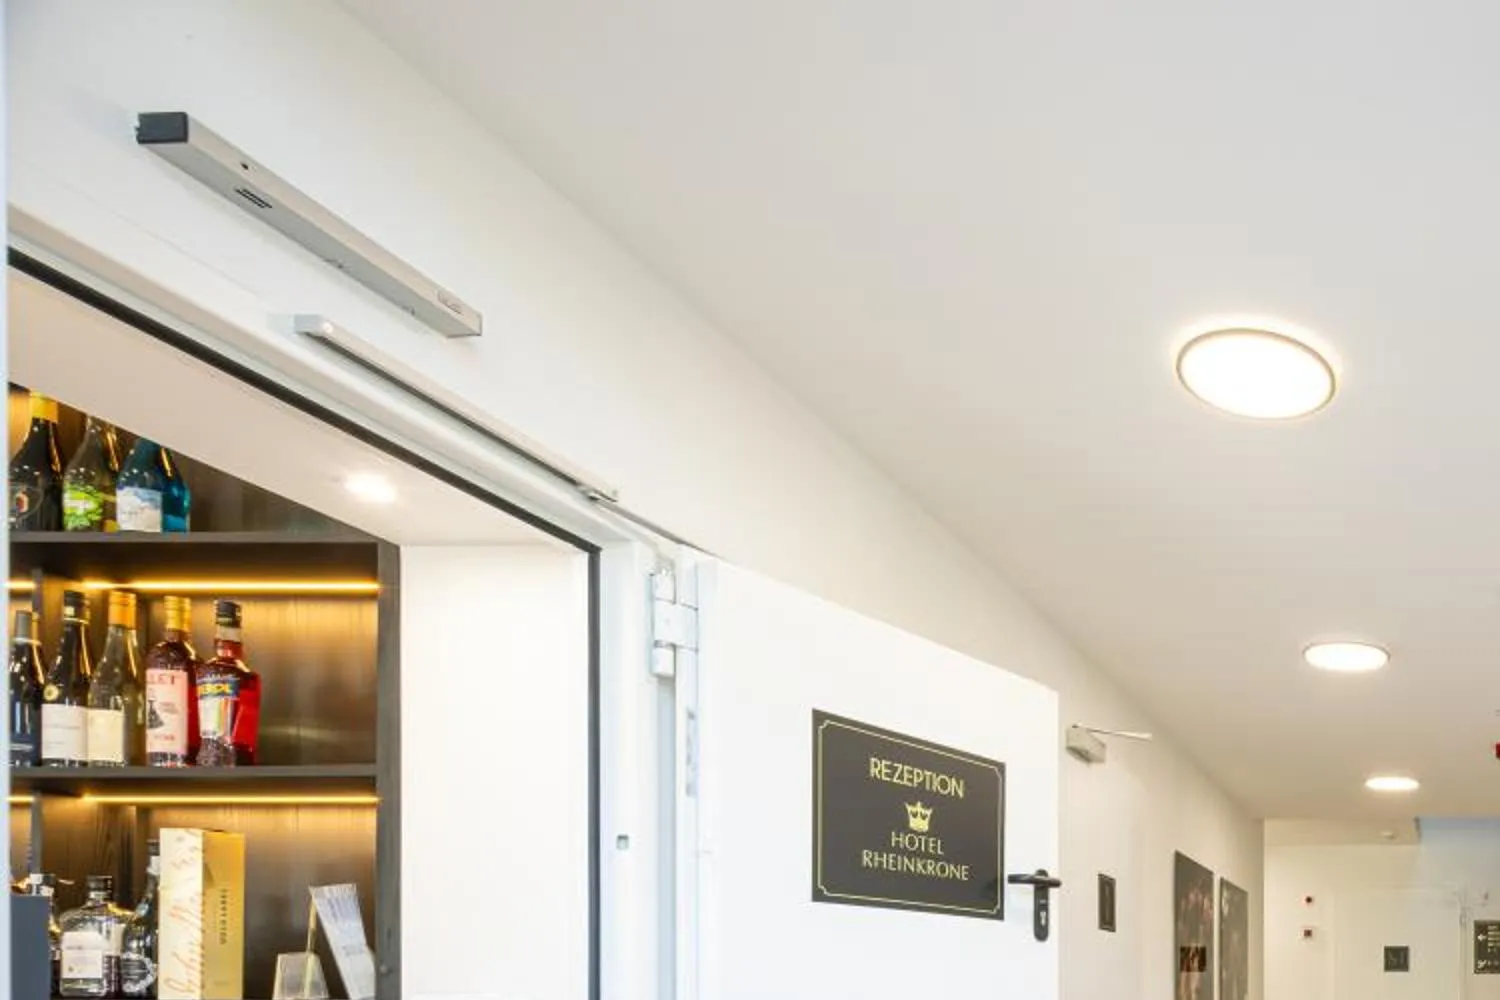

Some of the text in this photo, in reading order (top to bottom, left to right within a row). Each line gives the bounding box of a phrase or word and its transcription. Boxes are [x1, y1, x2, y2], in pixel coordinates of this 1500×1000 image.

[869, 757, 965, 799] REZEPTION
[891, 831, 944, 855] HOTEL
[862, 849, 969, 881] RHEINKRONE
